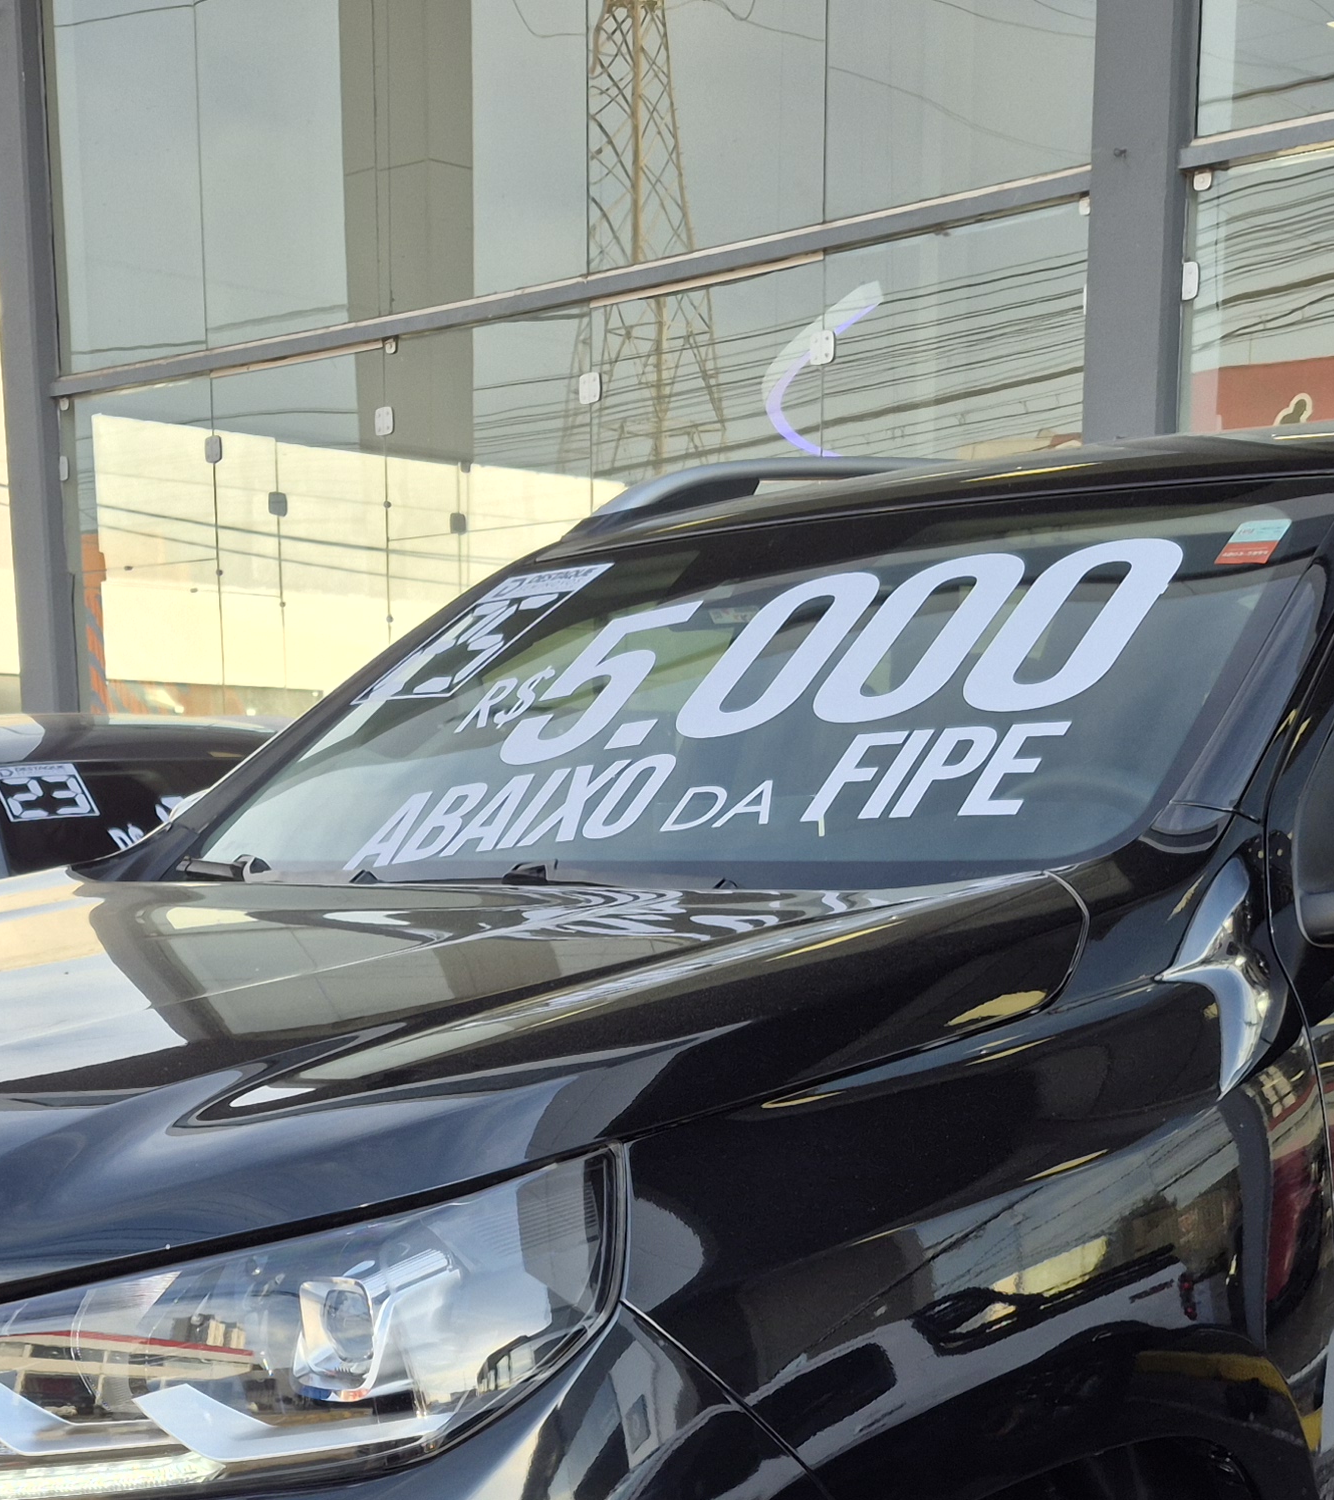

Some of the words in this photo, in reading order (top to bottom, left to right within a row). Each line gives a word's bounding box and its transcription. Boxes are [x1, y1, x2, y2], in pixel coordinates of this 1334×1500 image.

[1, 775, 92, 819] 23
[342, 753, 677, 871] ABAIXO
[659, 779, 774, 833] DA
[799, 720, 1073, 824] FIPE
